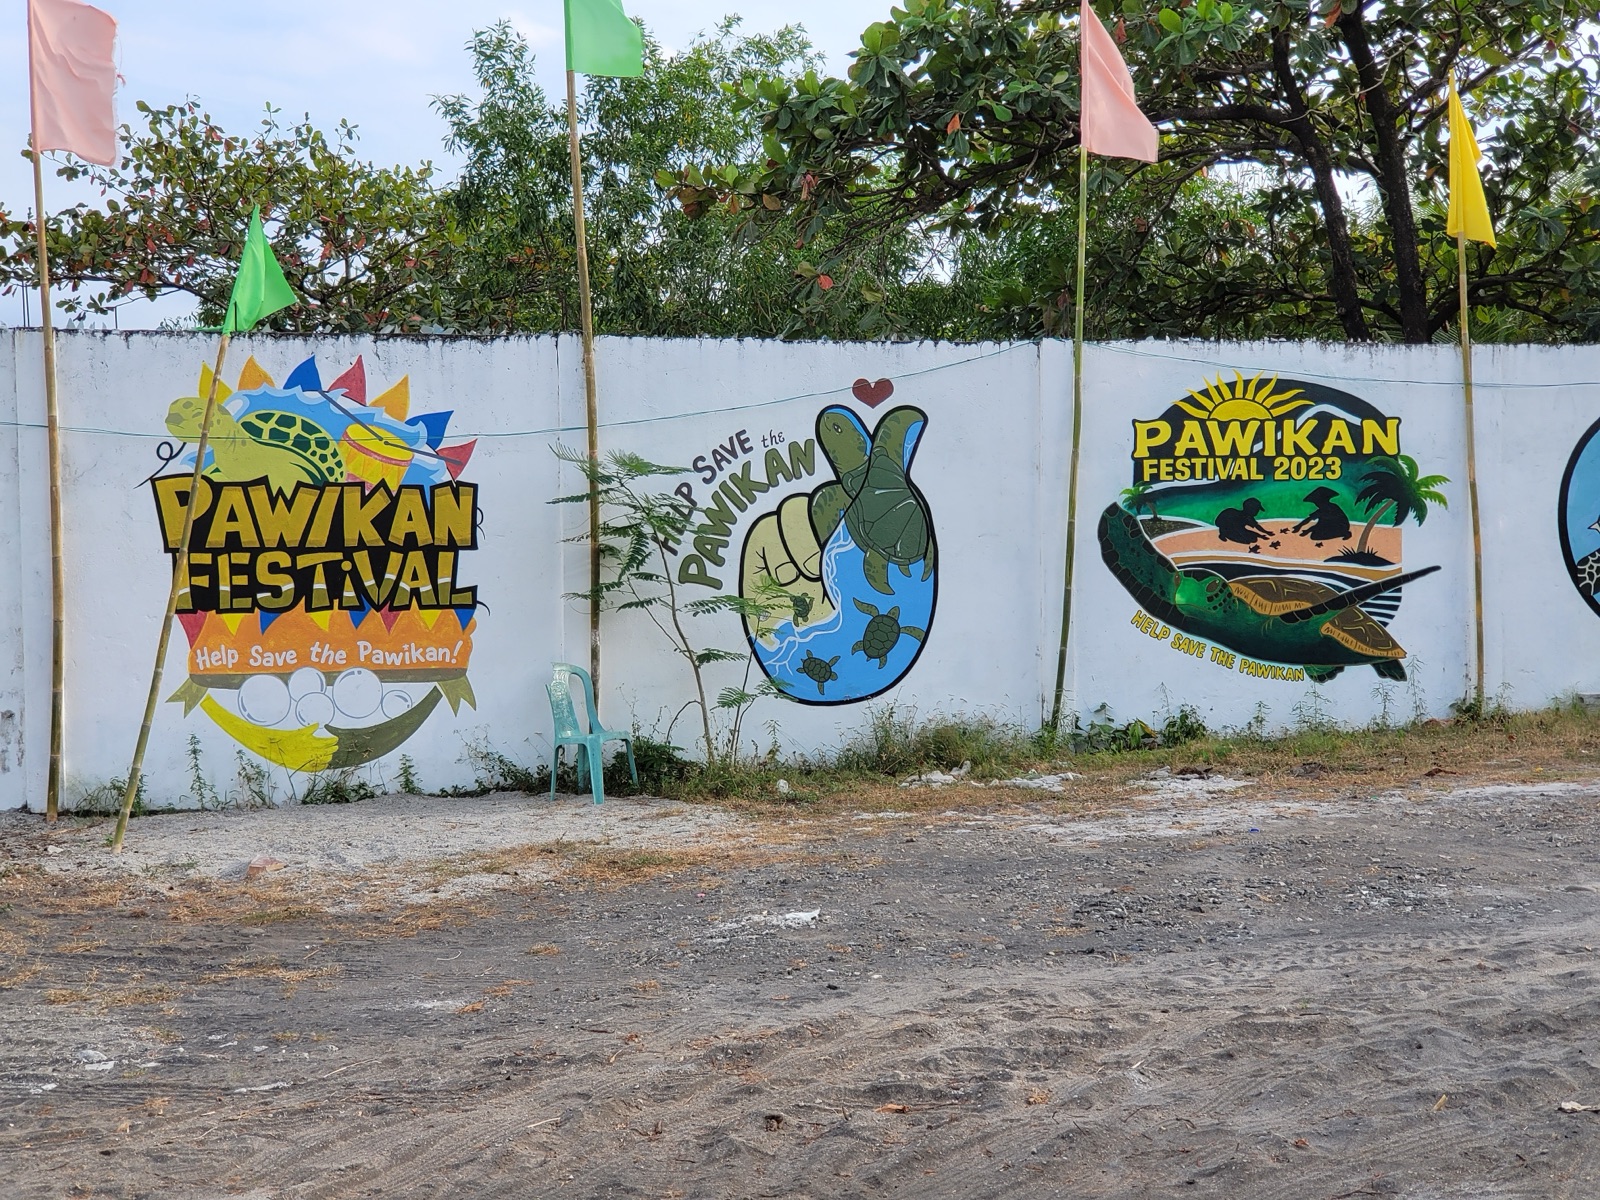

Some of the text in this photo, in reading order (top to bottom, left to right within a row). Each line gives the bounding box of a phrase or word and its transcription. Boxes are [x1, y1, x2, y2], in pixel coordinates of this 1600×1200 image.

[692, 429, 754, 484] SAVE
[760, 429, 786, 448] the
[1133, 419, 1400, 458] PAWIKAN
[1143, 456, 1342, 481] FESTIVAL 2023
[152, 473, 478, 550] PAWIKAN
[678, 438, 815, 590] PAWIKAN
[196, 640, 464, 669] Help Save the Pawikan!
[1131, 609, 1305, 682] HELP SAVE THE PAWIKAN
